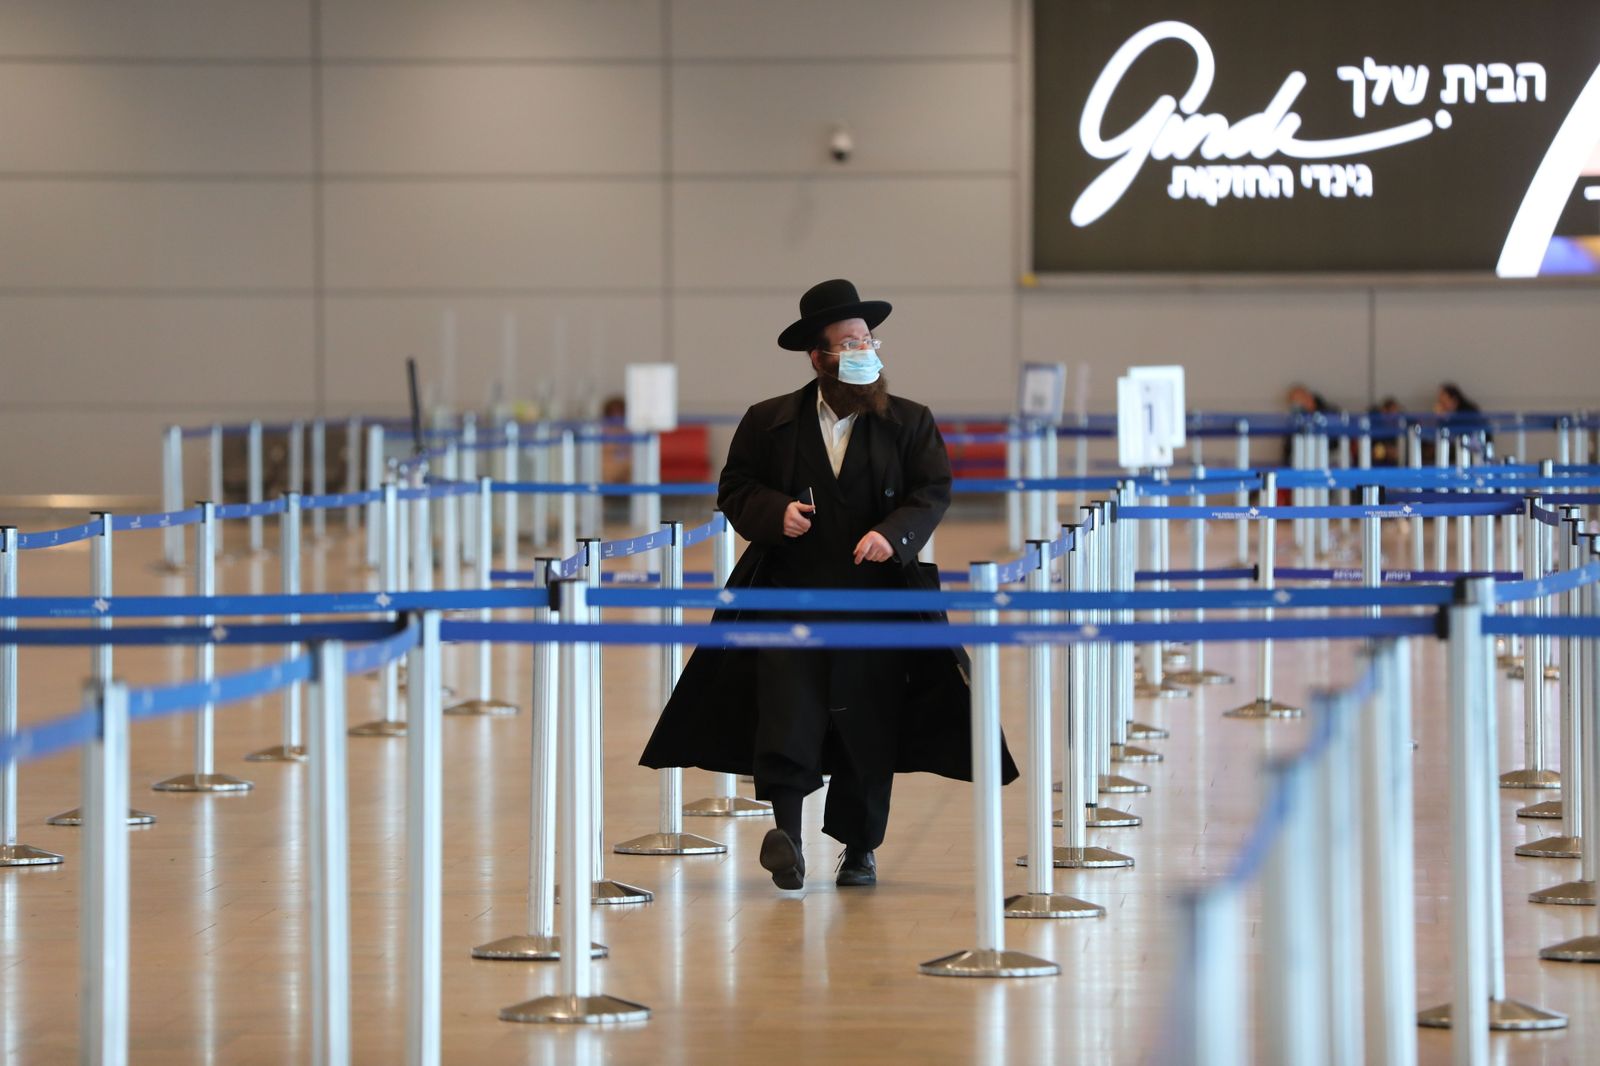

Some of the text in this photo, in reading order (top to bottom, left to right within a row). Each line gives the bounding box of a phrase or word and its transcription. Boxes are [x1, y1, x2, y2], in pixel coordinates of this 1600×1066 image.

[1337, 57, 1547, 118] הבית שלך
[1167, 164, 1373, 206] גינדי החזקות
